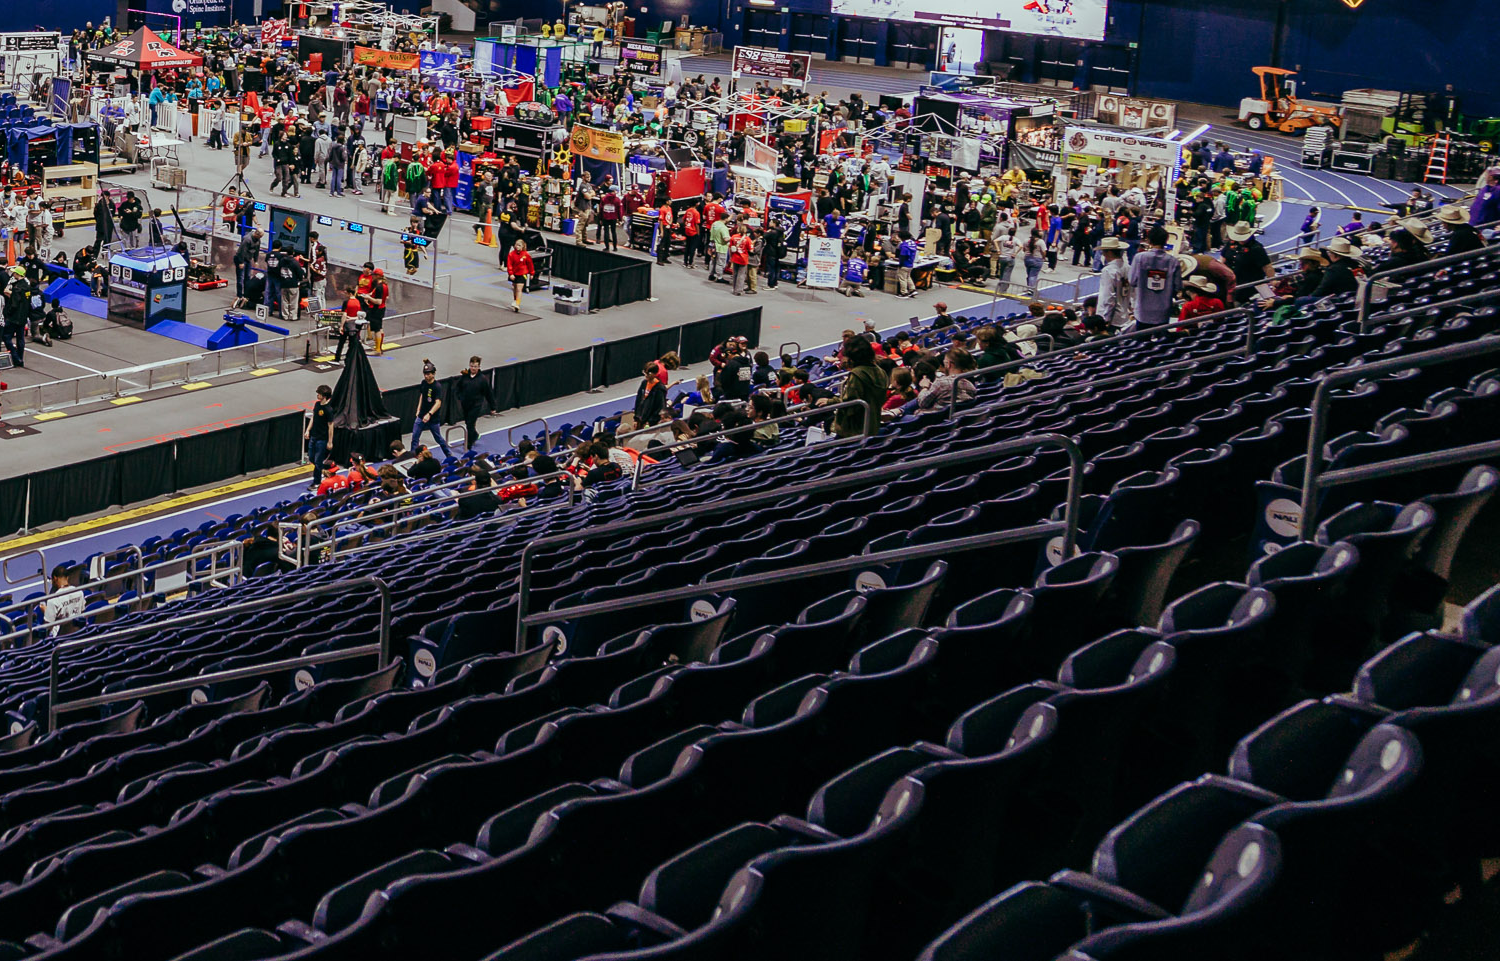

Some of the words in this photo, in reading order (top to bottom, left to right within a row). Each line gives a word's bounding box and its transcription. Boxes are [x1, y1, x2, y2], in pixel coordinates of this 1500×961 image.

[190, 5, 204, 14] Spine
[205, 4, 226, 13] Institute
[1094, 134, 1122, 143] CYBER
[1138, 140, 1167, 150] VIPERS
[1273, 513, 1298, 523] NAU
